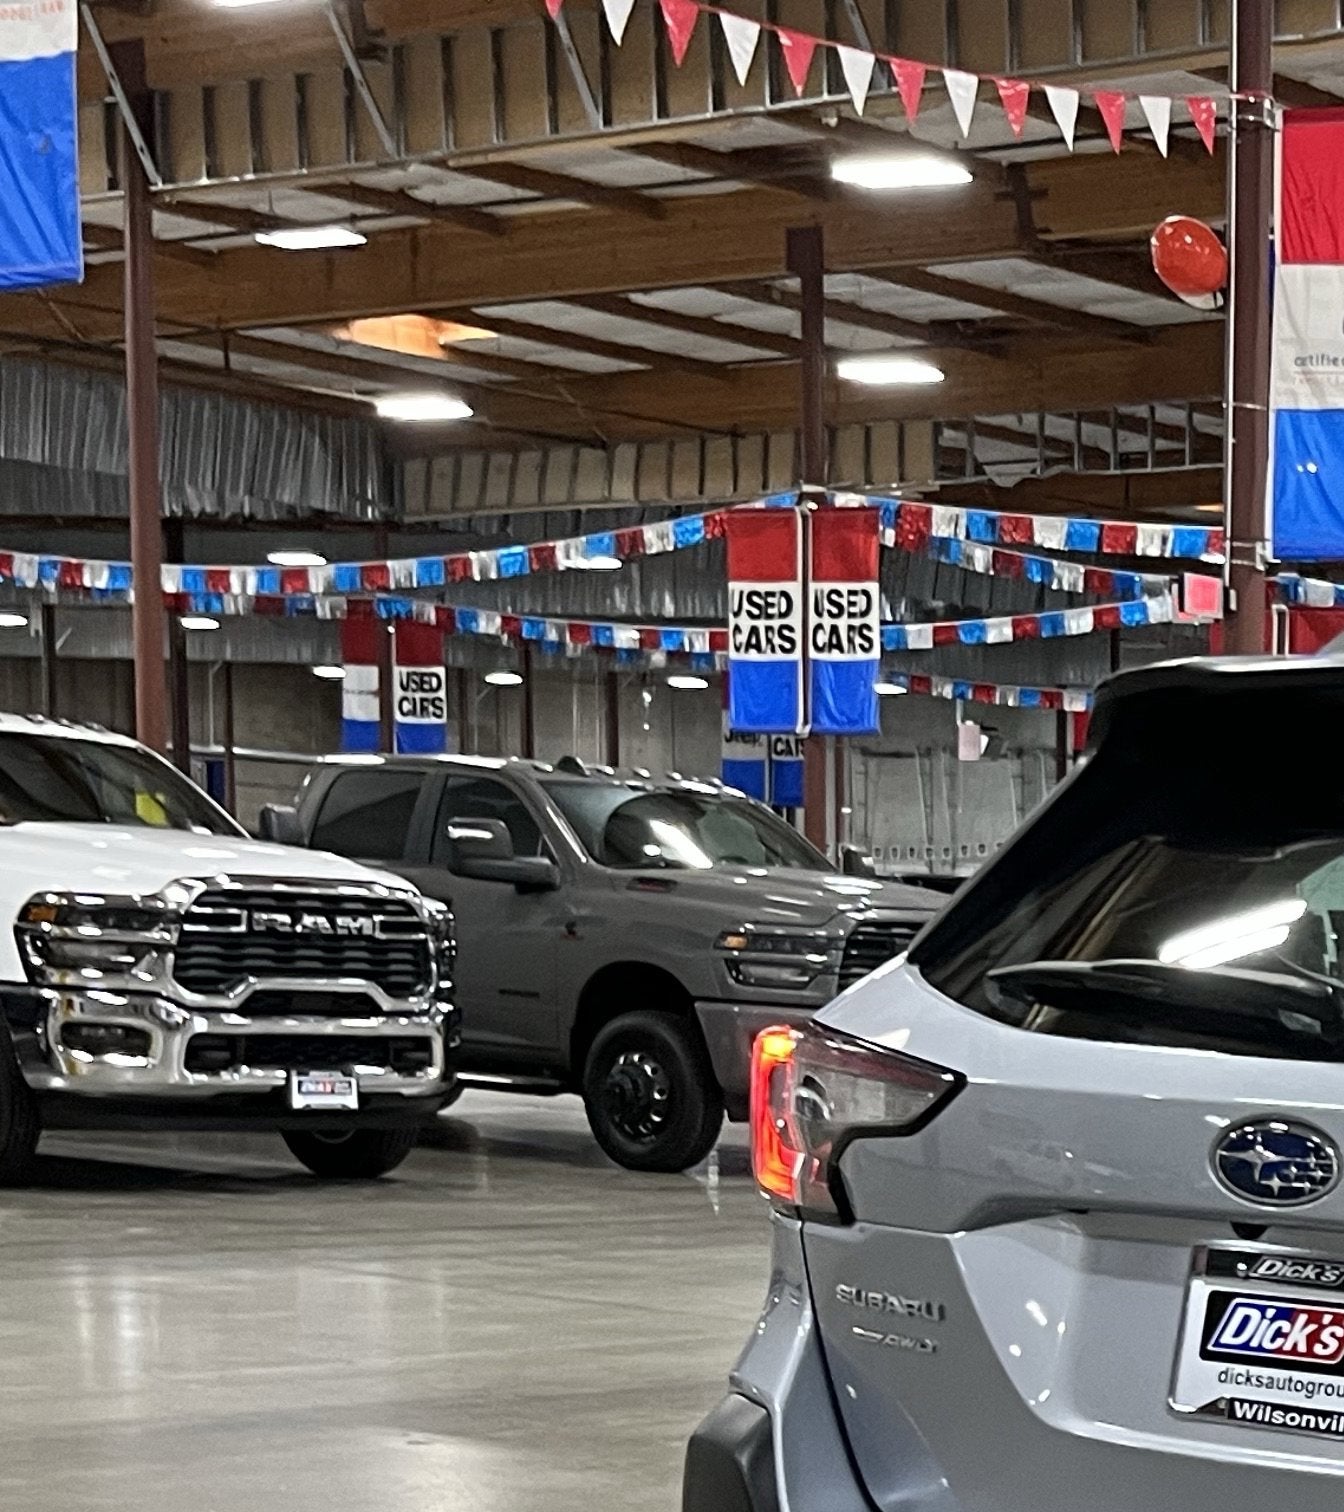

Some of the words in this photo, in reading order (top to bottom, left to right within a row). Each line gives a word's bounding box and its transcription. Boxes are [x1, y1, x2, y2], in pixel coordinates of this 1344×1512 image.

[731, 588, 794, 620] USED
[814, 588, 872, 619] USED
[732, 623, 797, 654] CARS
[812, 622, 874, 654] CARS
[400, 672, 442, 693] USED
[251, 911, 374, 936] RAM
[1257, 1258, 1341, 1282] Dick's
[835, 1283, 941, 1321] SUBARU
